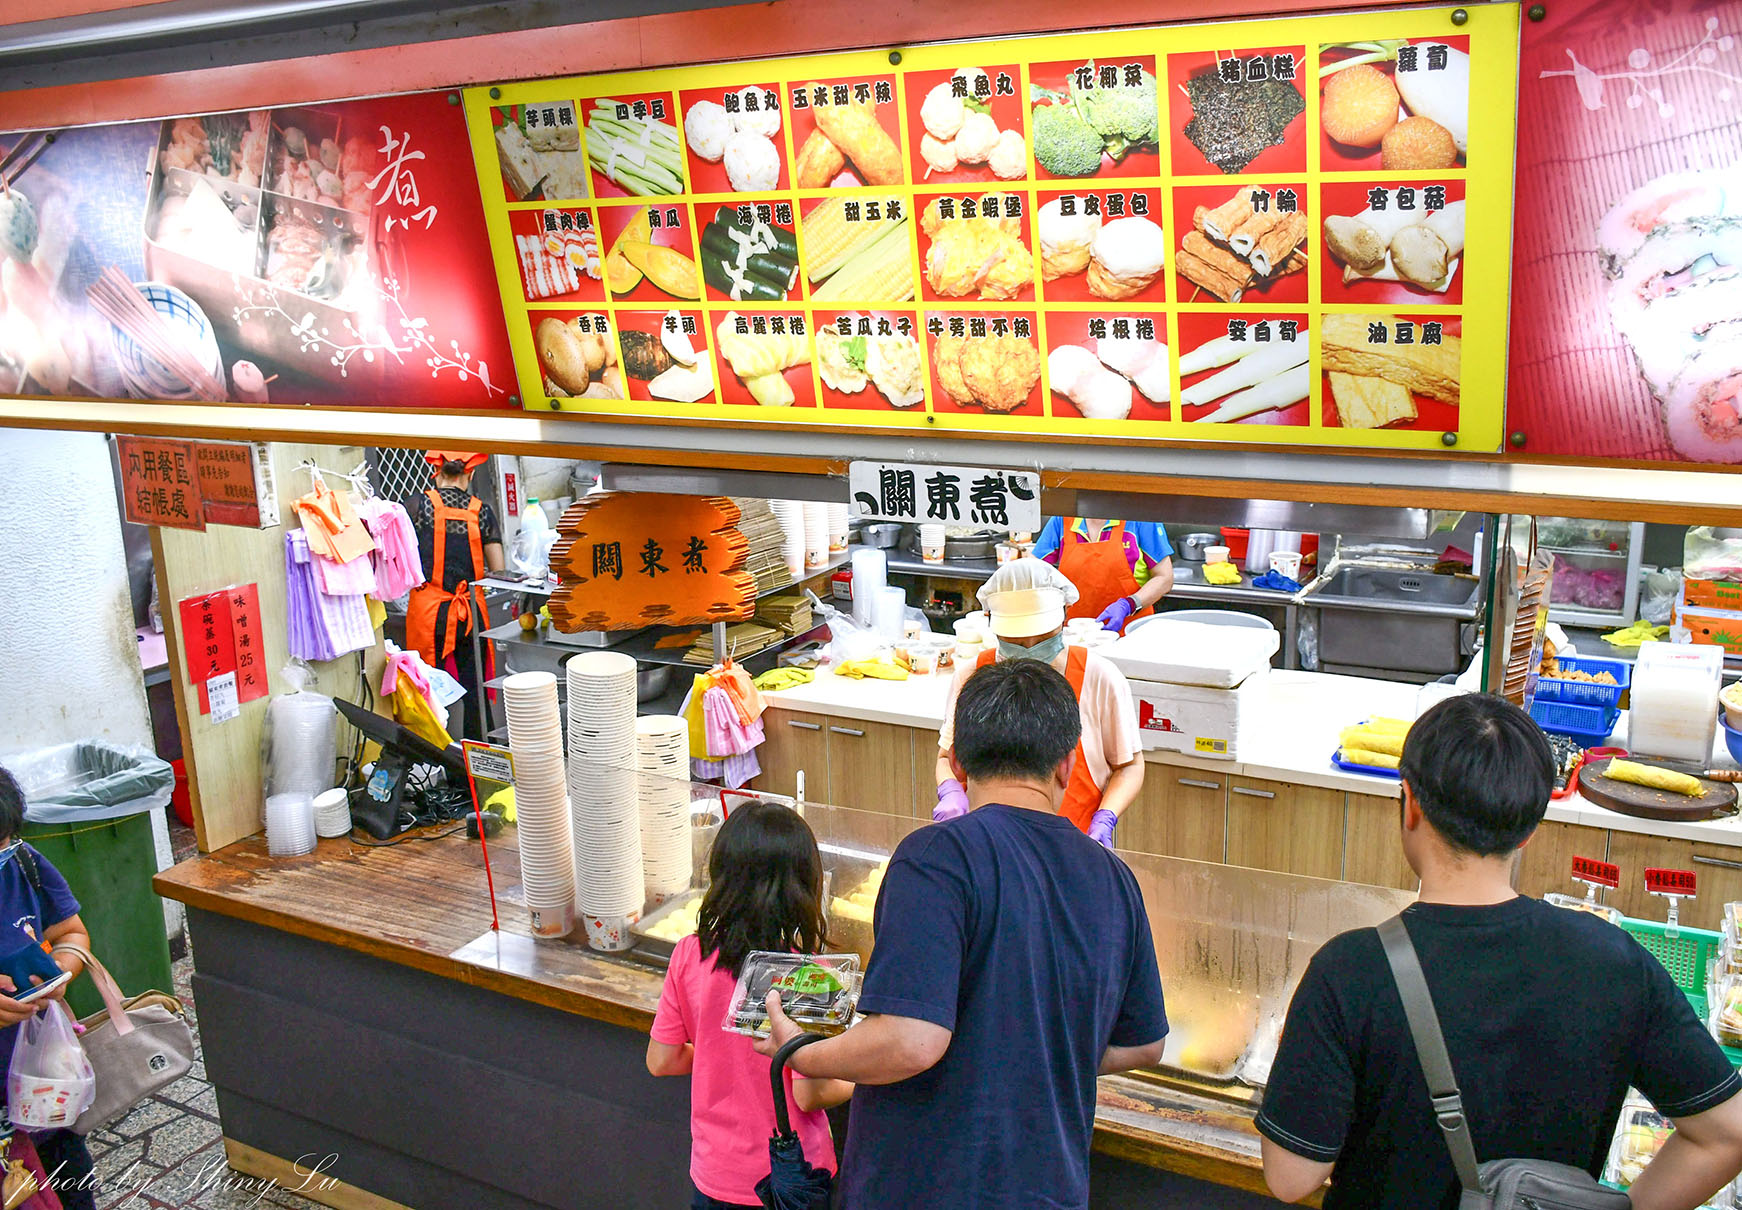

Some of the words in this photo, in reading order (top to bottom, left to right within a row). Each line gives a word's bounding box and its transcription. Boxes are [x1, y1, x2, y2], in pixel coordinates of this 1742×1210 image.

[1220, 54, 1295, 82] 豬血糕
[1398, 45, 1448, 72] 蘿蔔
[951, 73, 1014, 98] 飛魚丸
[1075, 64, 1143, 90] 花椰菜
[724, 90, 779, 113] 鮑魚丸
[793, 82, 891, 109] 玉米甜不辣
[526, 107, 573, 127] 芋頭粿
[615, 99, 665, 120] 四季豆
[939, 197, 1022, 219] 黃金蝦堡
[1059, 194, 1149, 216] 豆皮蛋包
[1250, 190, 1297, 212] 竹輪
[1368, 186, 1445, 211] 杏包菇
[648, 209, 681, 228] 南瓜
[738, 204, 792, 225] 海帶捲
[844, 199, 902, 221] 甜玉米
[544, 212, 590, 232] 蟹肉棒
[579, 316, 608, 333] 香菇
[664, 316, 696, 334] 芋頭
[735, 316, 805, 335] 高麗菜捲
[836, 317, 913, 336] 苦瓜丸子
[928, 317, 1031, 338] 牛蒡甜不辣
[1088, 319, 1155, 339] 培根捲
[1368, 322, 1442, 344] 油豆腐
[136, 485, 189, 519] 結帳處
[879, 469, 1008, 525] 關東煮
[592, 535, 708, 581] 關東煮
